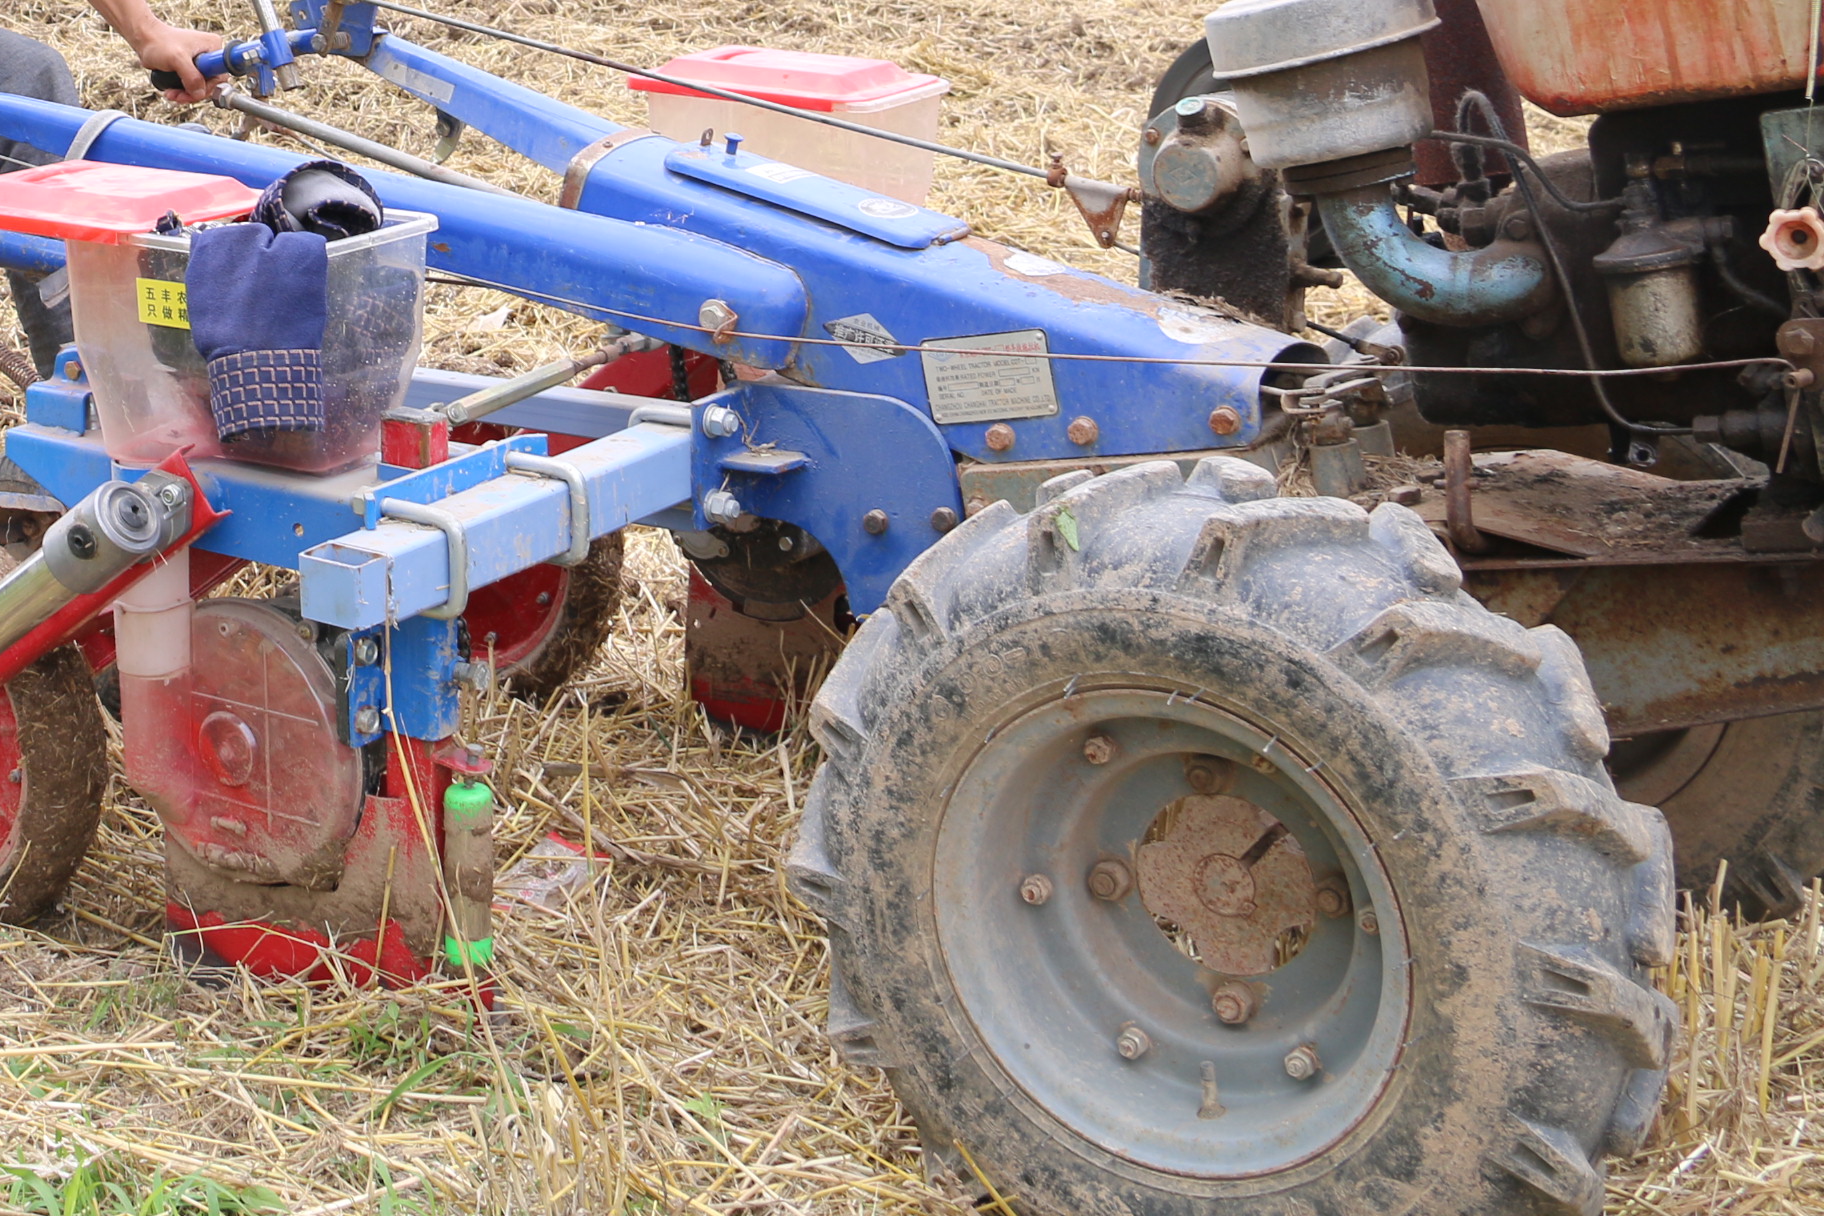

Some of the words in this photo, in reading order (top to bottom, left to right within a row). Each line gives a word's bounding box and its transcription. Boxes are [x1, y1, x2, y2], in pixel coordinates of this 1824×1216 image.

[936, 364, 967, 373] TWO-WHEEL
[969, 361, 992, 370] TRACTOR
[993, 359, 1010, 367] MODEL
[960, 372, 977, 381] RATED
[977, 371, 996, 379] POWER
[988, 398, 1010, 407] TRACTOR
